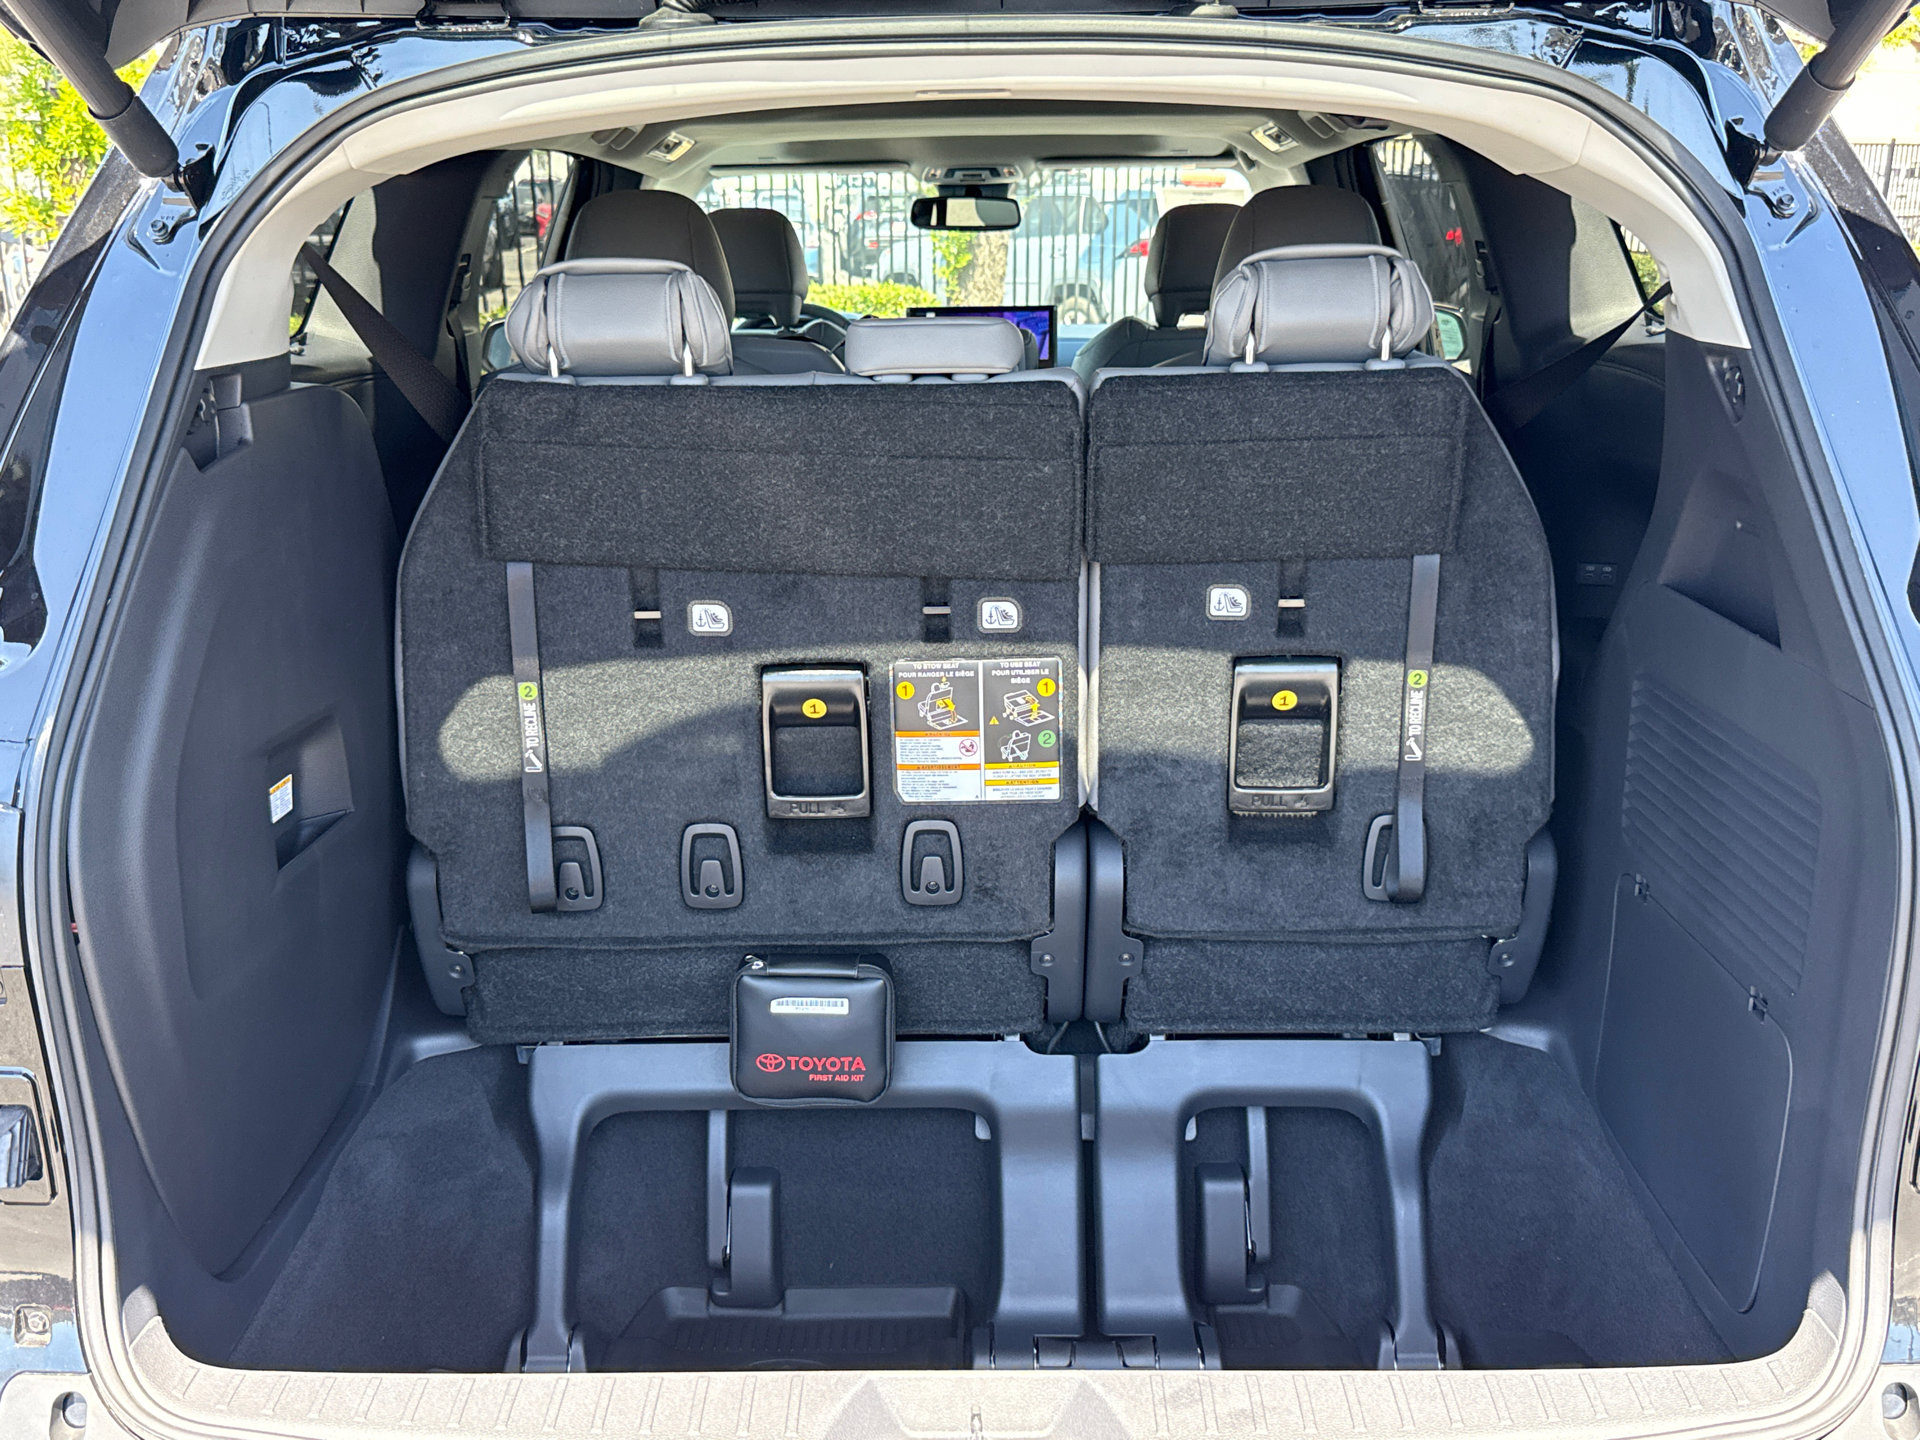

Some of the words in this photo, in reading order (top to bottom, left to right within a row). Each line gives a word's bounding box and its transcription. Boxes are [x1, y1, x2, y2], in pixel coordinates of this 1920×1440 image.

[1413, 673, 1422, 685] 2
[524, 686, 533, 698] 2
[1279, 695, 1289, 706] 1
[809, 703, 820, 714] 1
[1409, 690, 1424, 725] RECLINE
[523, 702, 539, 737] RECLINE
[1408, 725, 1422, 737] TO
[525, 736, 540, 749] TO
[1043, 732, 1052, 744] 2
[1251, 795, 1288, 807] PULL
[789, 802, 825, 814] PULL
[786, 1056, 866, 1072] TOYOTA
[808, 1073, 832, 1082] FIRST
[834, 1073, 849, 1082] AID
[851, 1073, 865, 1082] KIT
